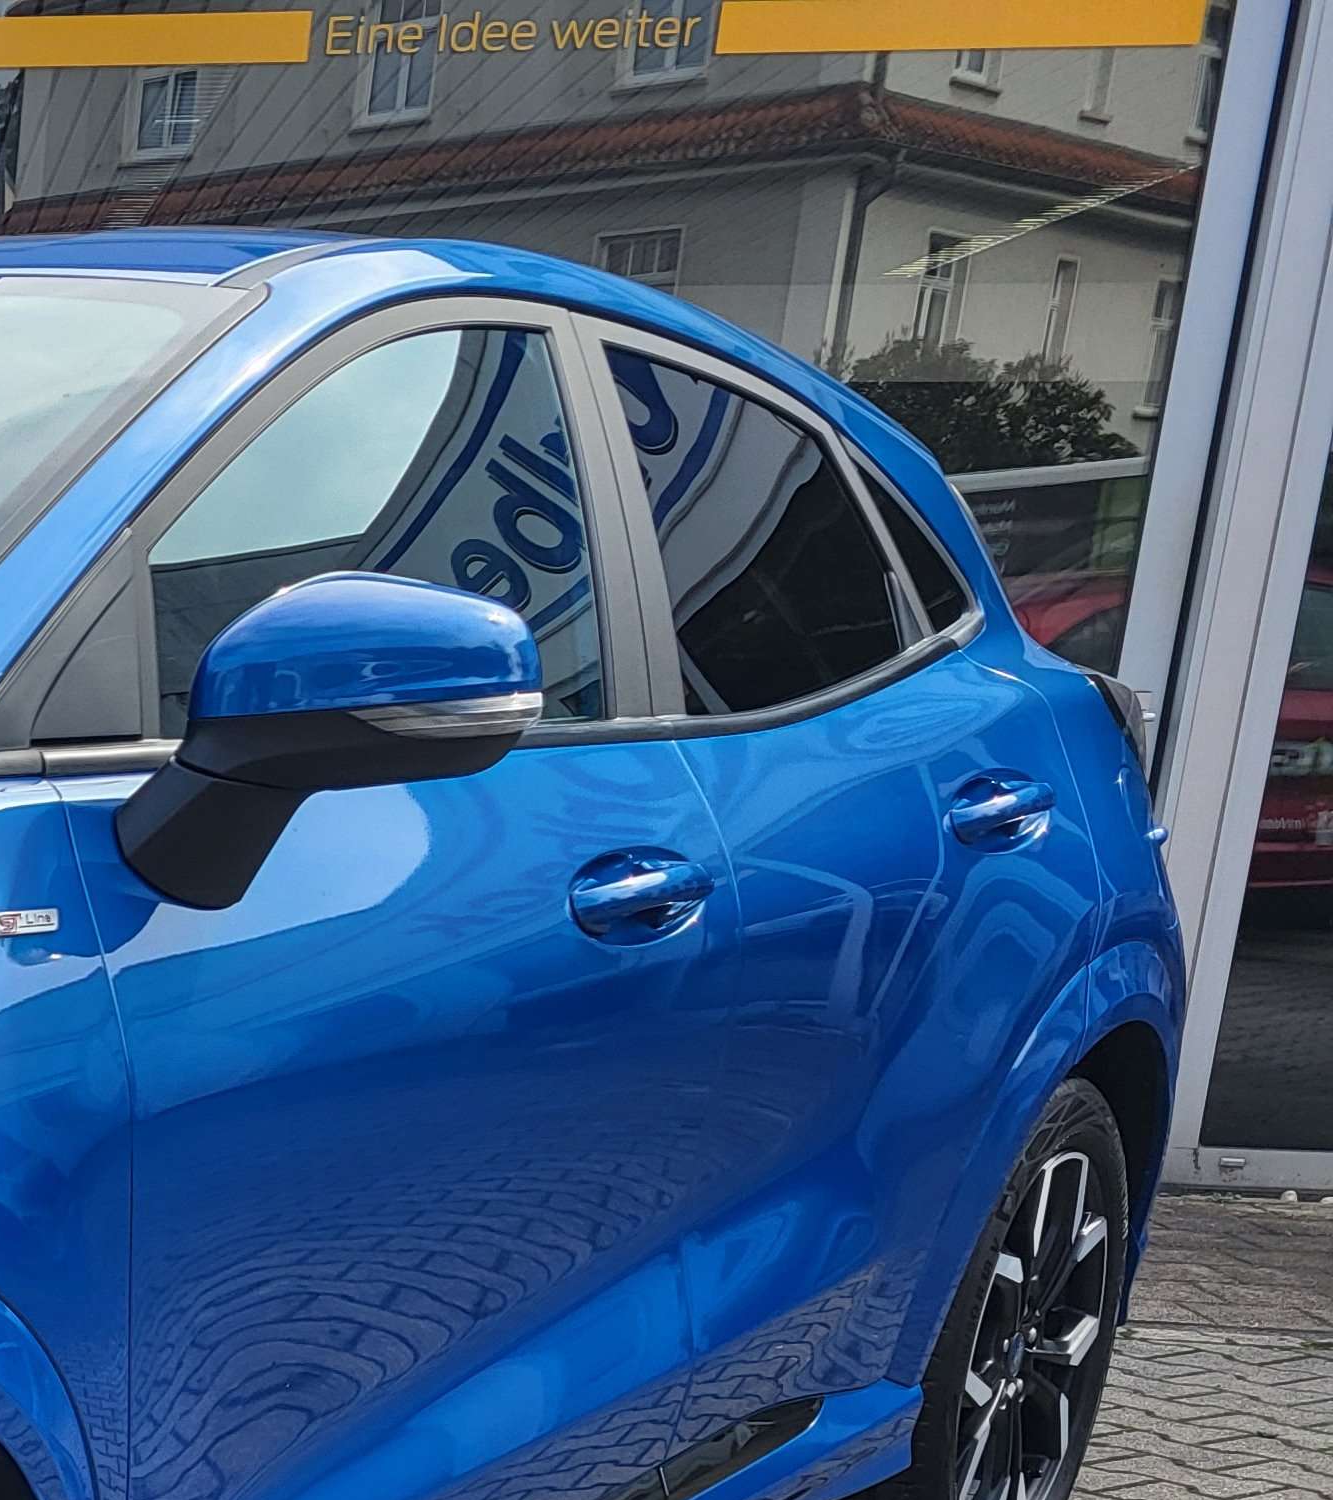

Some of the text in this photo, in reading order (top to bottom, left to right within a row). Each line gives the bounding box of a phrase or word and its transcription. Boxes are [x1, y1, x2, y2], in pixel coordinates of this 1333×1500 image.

[324, 8, 701, 56] Eine Idee weiter
